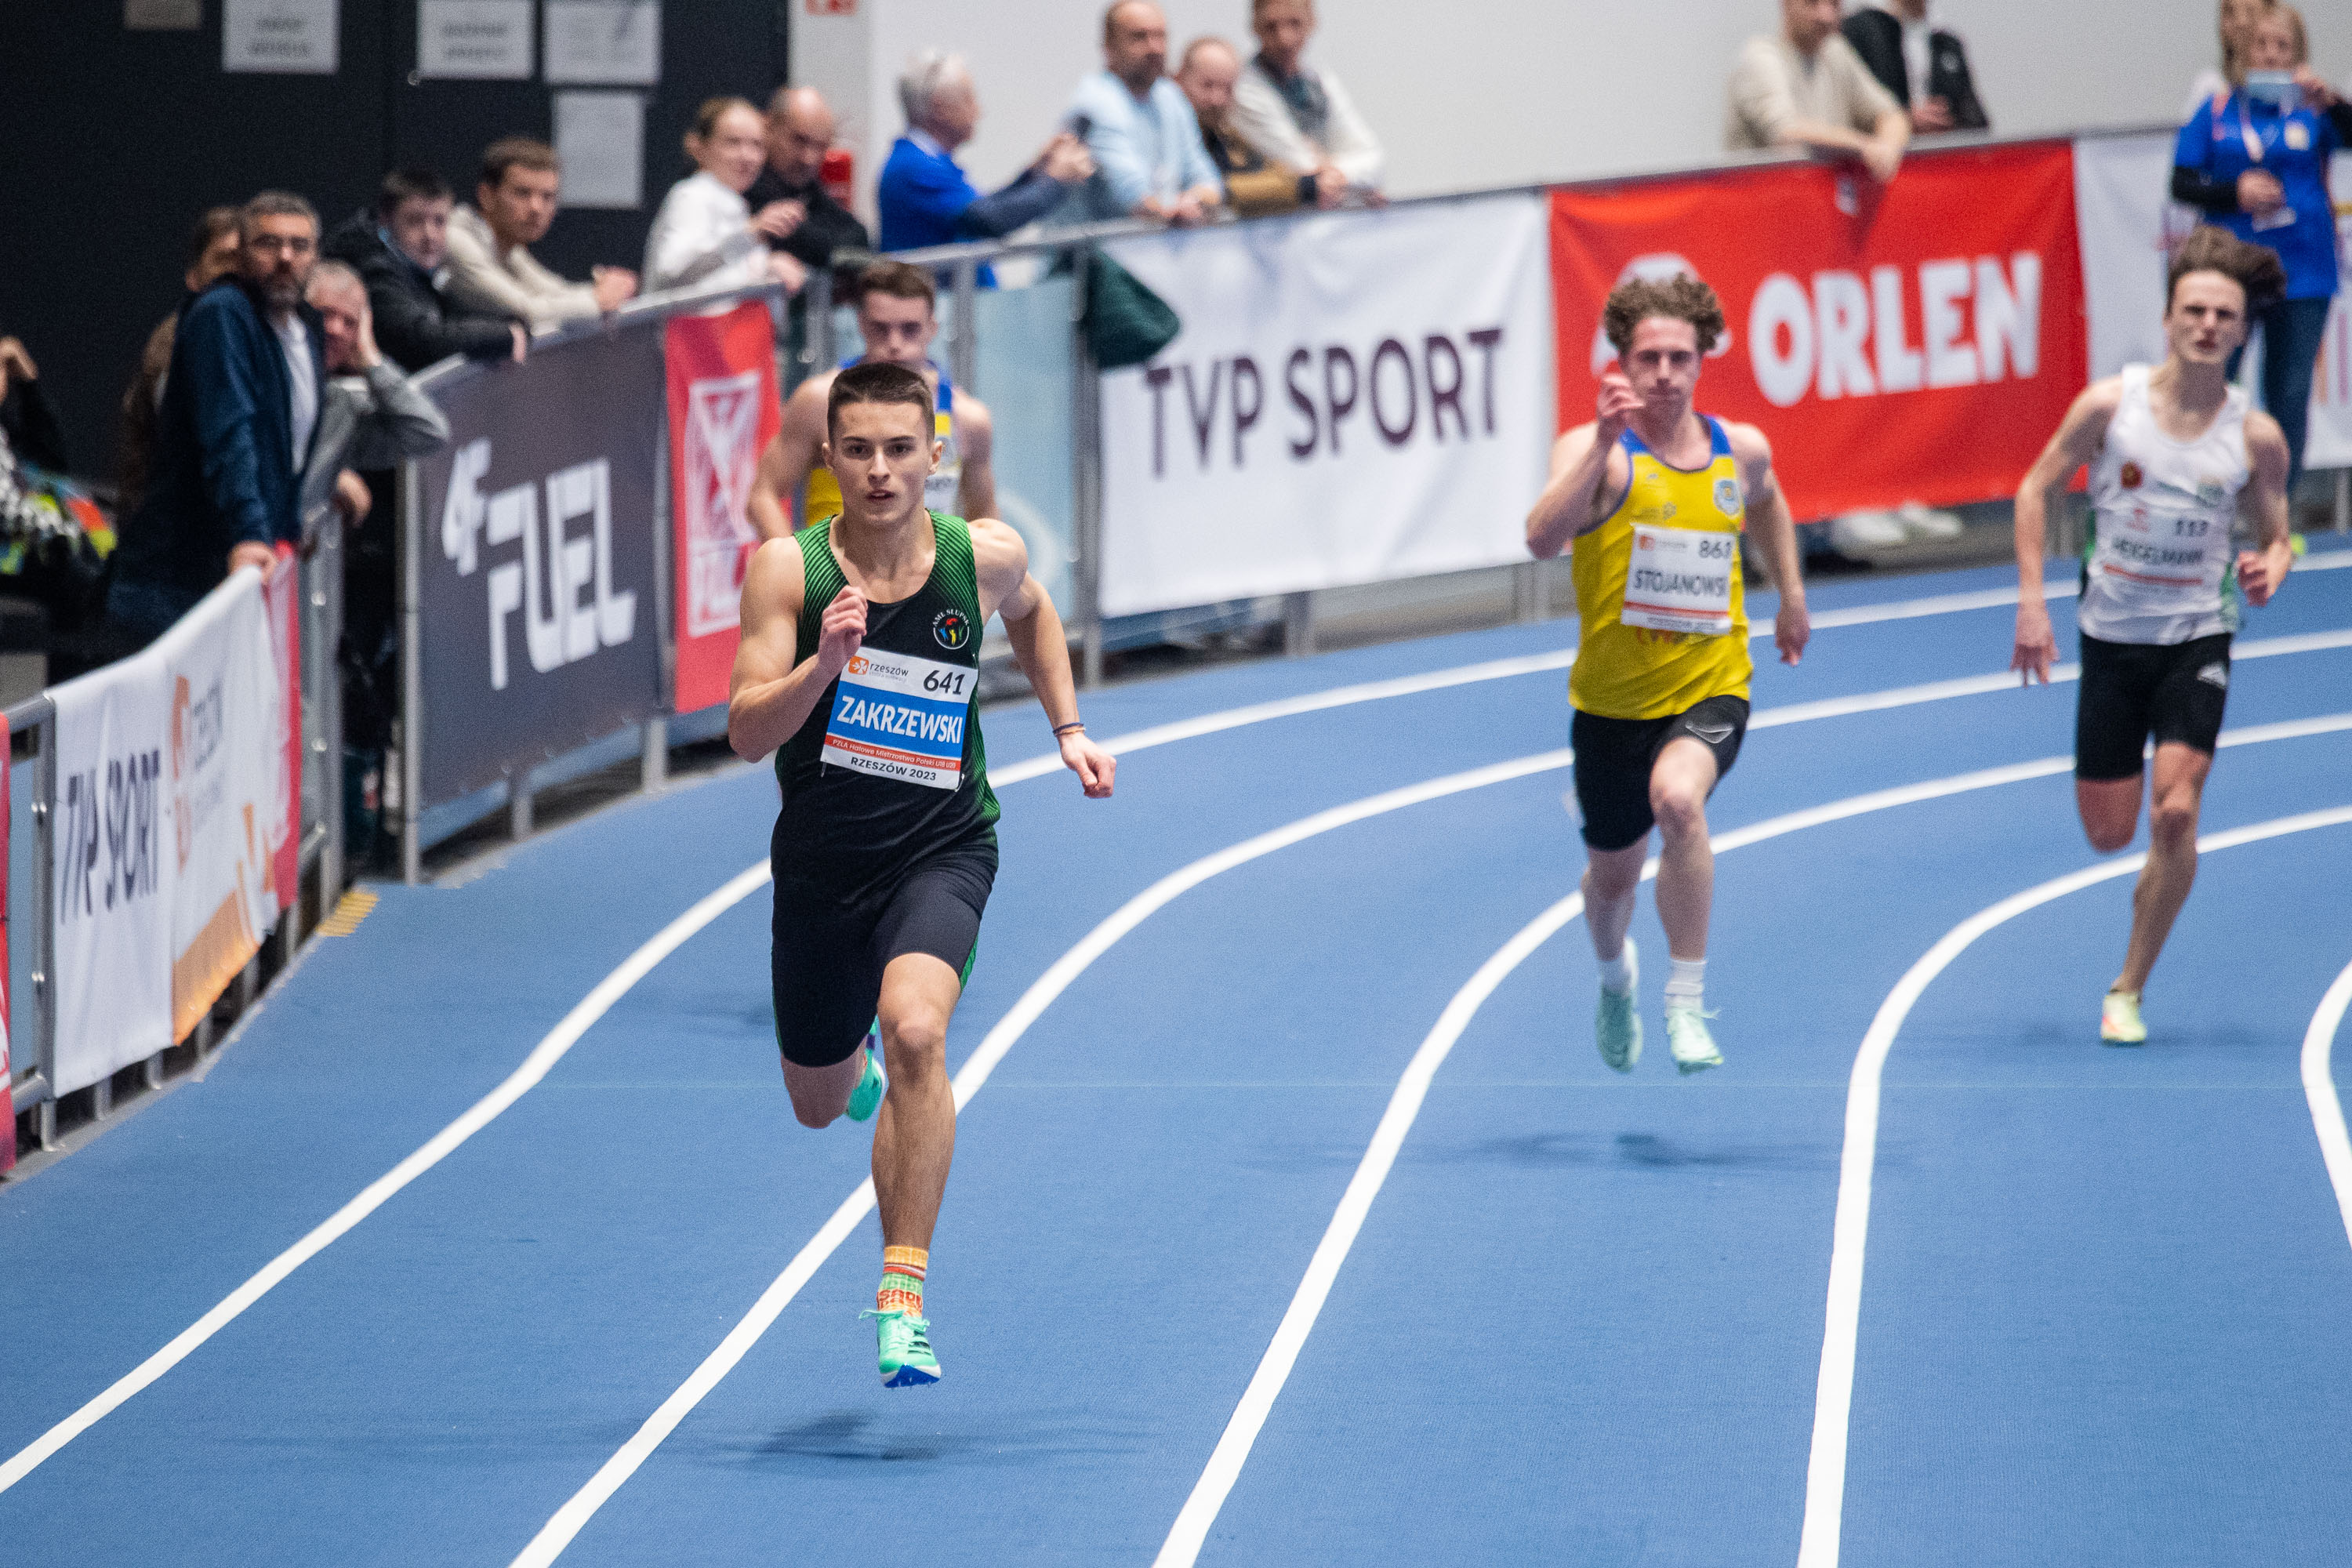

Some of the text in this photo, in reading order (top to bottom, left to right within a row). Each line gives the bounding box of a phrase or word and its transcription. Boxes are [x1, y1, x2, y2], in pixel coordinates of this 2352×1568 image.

[1748, 250, 2041, 408] ORLEN
[1144, 328, 1503, 479] TVP SPORT
[487, 457, 637, 690] FUEL
[869, 664, 909, 677] rzeszów
[924, 670, 965, 695] 641
[837, 695, 964, 744] ZAKRZEWSKI
[851, 757, 937, 781] RZESZÓW 2023
[876, 749, 915, 763] Mistrzostwa
